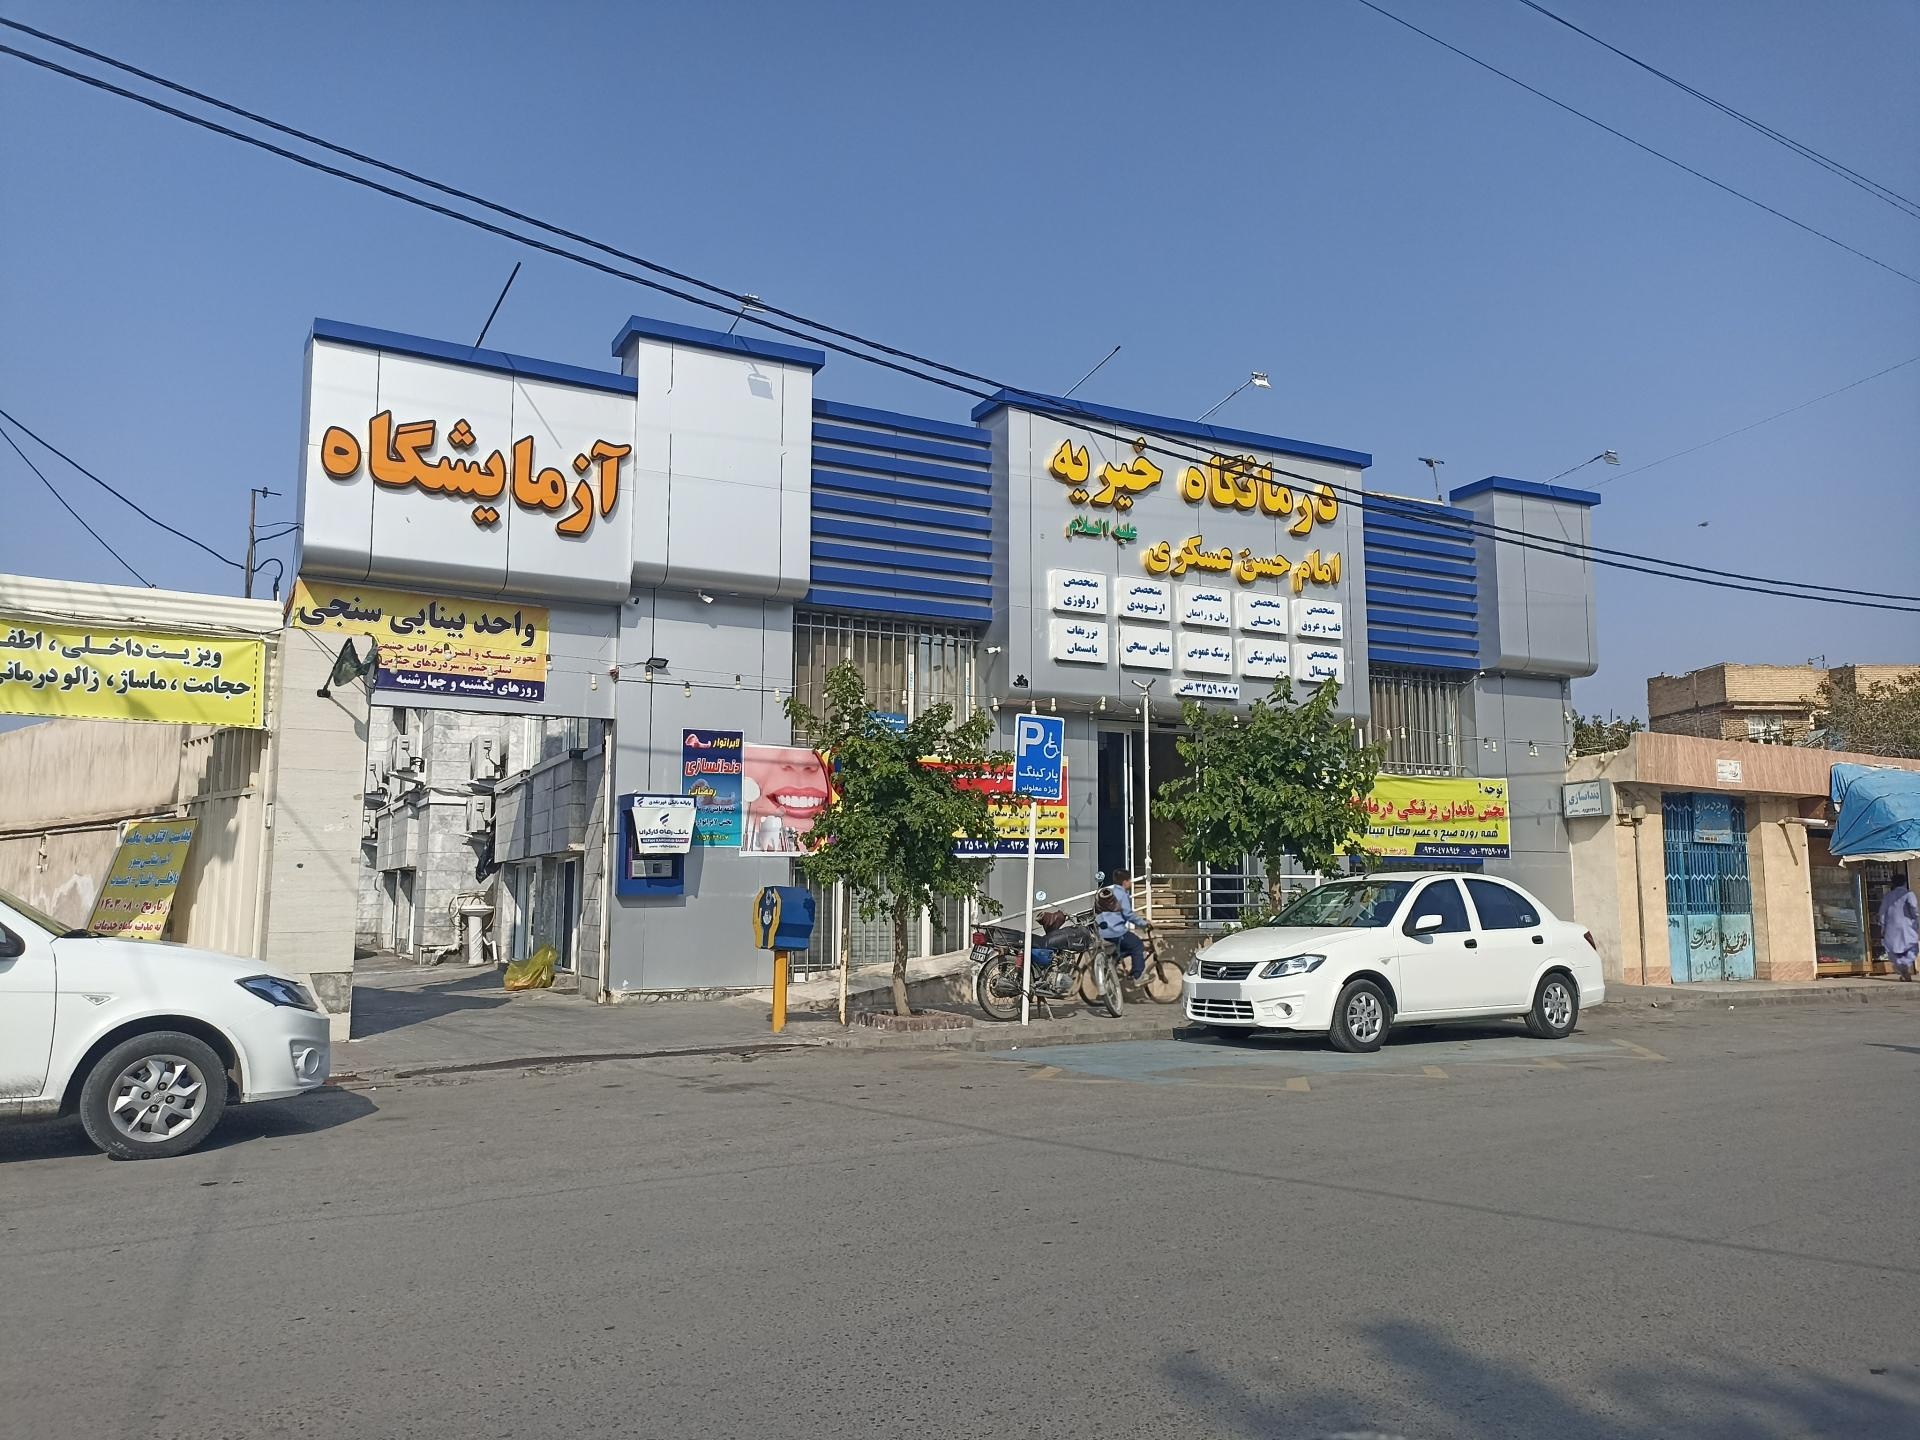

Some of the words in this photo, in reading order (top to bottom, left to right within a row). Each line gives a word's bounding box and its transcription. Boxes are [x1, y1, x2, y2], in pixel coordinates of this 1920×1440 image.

[321, 410, 632, 535] آزمایشگاه
[1051, 438, 1163, 508] خیریه
[1183, 454, 1339, 535] درمانگاه
[1147, 535, 1233, 577] عسکری
[1238, 548, 1291, 584] حسن
[1296, 550, 1341, 590] امام
[1064, 578, 1098, 588] متخصص
[1130, 586, 1162, 595] متخصص
[1192, 592, 1222, 602] متخصص
[1250, 599, 1280, 609] متخصص
[299, 597, 383, 627] سنجی
[1307, 605, 1335, 615] متخصص
[389, 601, 467, 639] بینایی
[473, 610, 536, 647] واحد
[1250, 616, 1280, 626] داخلی
[1301, 622, 1320, 632] عروق
[1328, 624, 1341, 633] قلب
[0, 629, 43, 651] اطف
[145, 641, 222, 668] ویزیت
[1187, 648, 1210, 659] عمومی
[1212, 647, 1230, 661] پزشک
[1307, 650, 1338, 660] متخصص
[60, 665, 100, 692] زالو
[396, 673, 448, 690] چهارشنبه
[450, 680, 457, 689] و
[459, 677, 495, 694] یکشنبه
[497, 681, 538, 698] روزهای
[1195, 683, 1238, 695] ۳۲۵۹۰۷۰۷
[1019, 721, 1045, 757] P
[685, 758, 742, 776] دندانسازی
[1018, 765, 1058, 783] پارکینگ
[1017, 784, 1042, 793] معلولین
[1043, 786, 1058, 796] ویژه
[1397, 798, 1438, 821] پزشکی
[1442, 800, 1475, 821] دندان
[1478, 801, 1505, 822] بخش
[1412, 828, 1431, 838] عصر
[1440, 829, 1458, 841] صبح
[1481, 829, 1498, 838] همه
[1007, 841, 1059, 850] ۰۹۳۶۰۷۸۹۴۶
